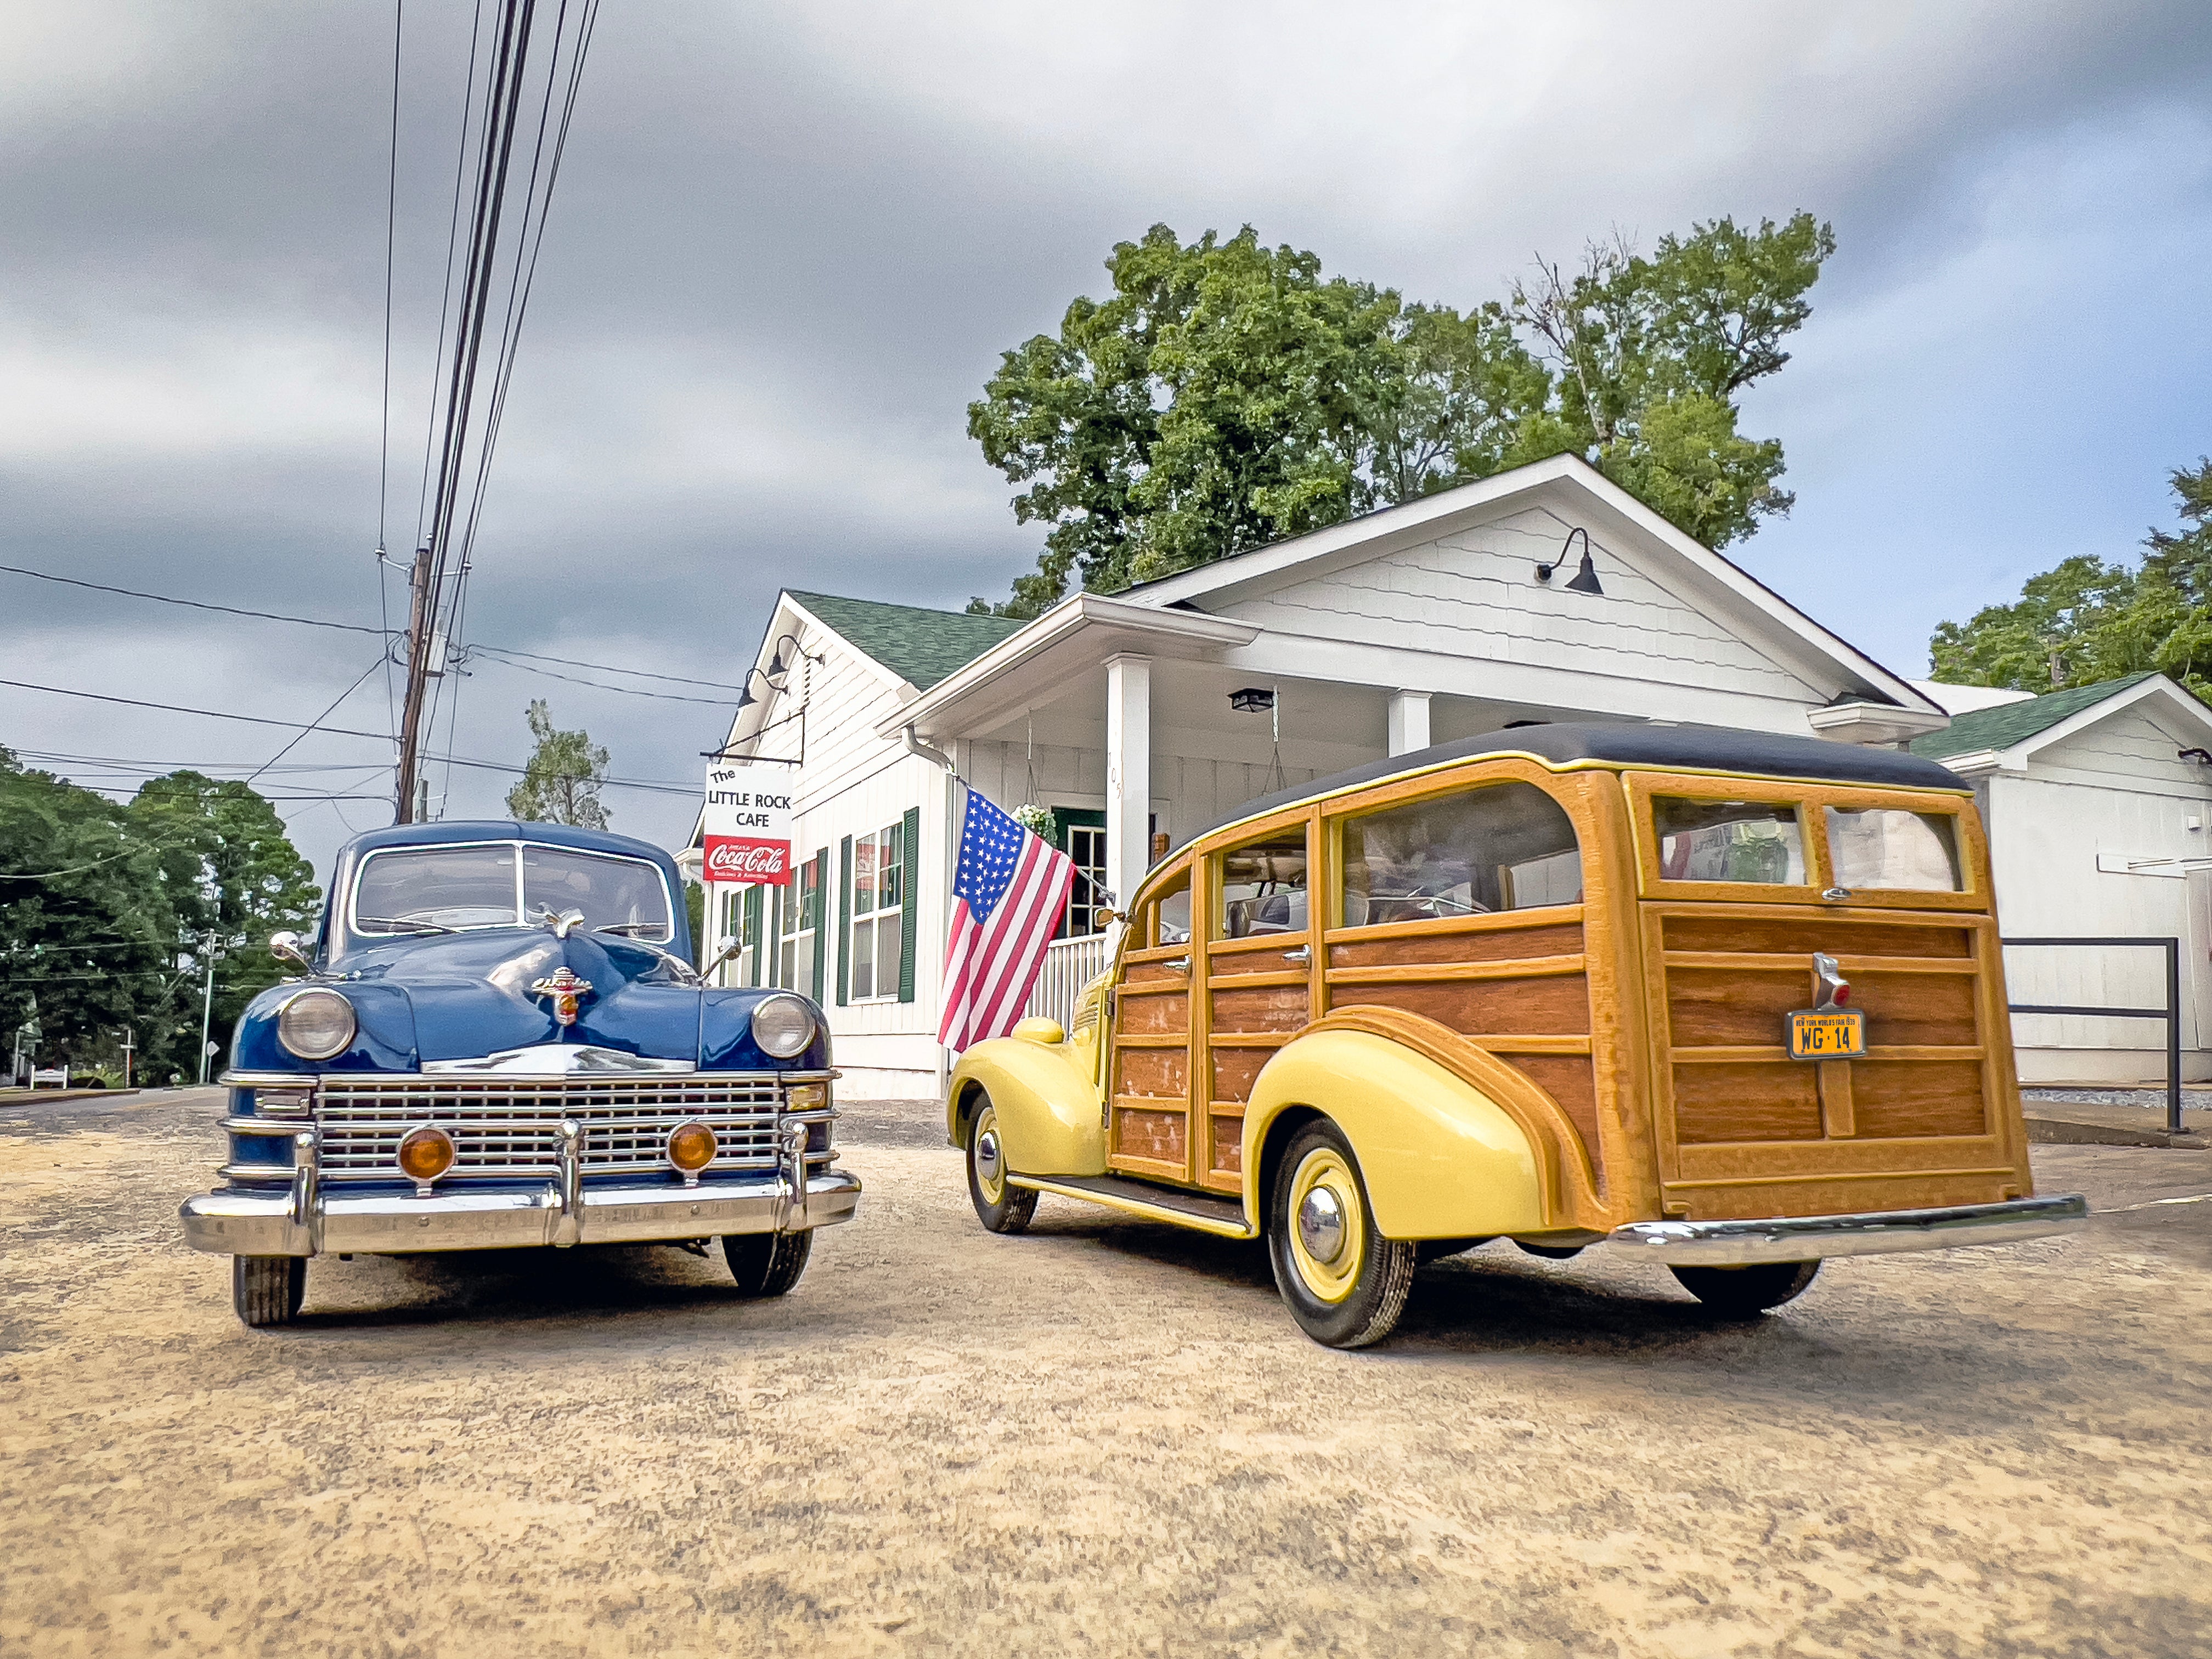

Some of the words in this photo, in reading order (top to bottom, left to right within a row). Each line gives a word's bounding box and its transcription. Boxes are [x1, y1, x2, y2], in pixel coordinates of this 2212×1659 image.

[710, 770, 736, 783] The
[709, 790, 750, 806] LITTLE
[755, 794, 791, 810] ROCK
[736, 812, 769, 827] CAFE
